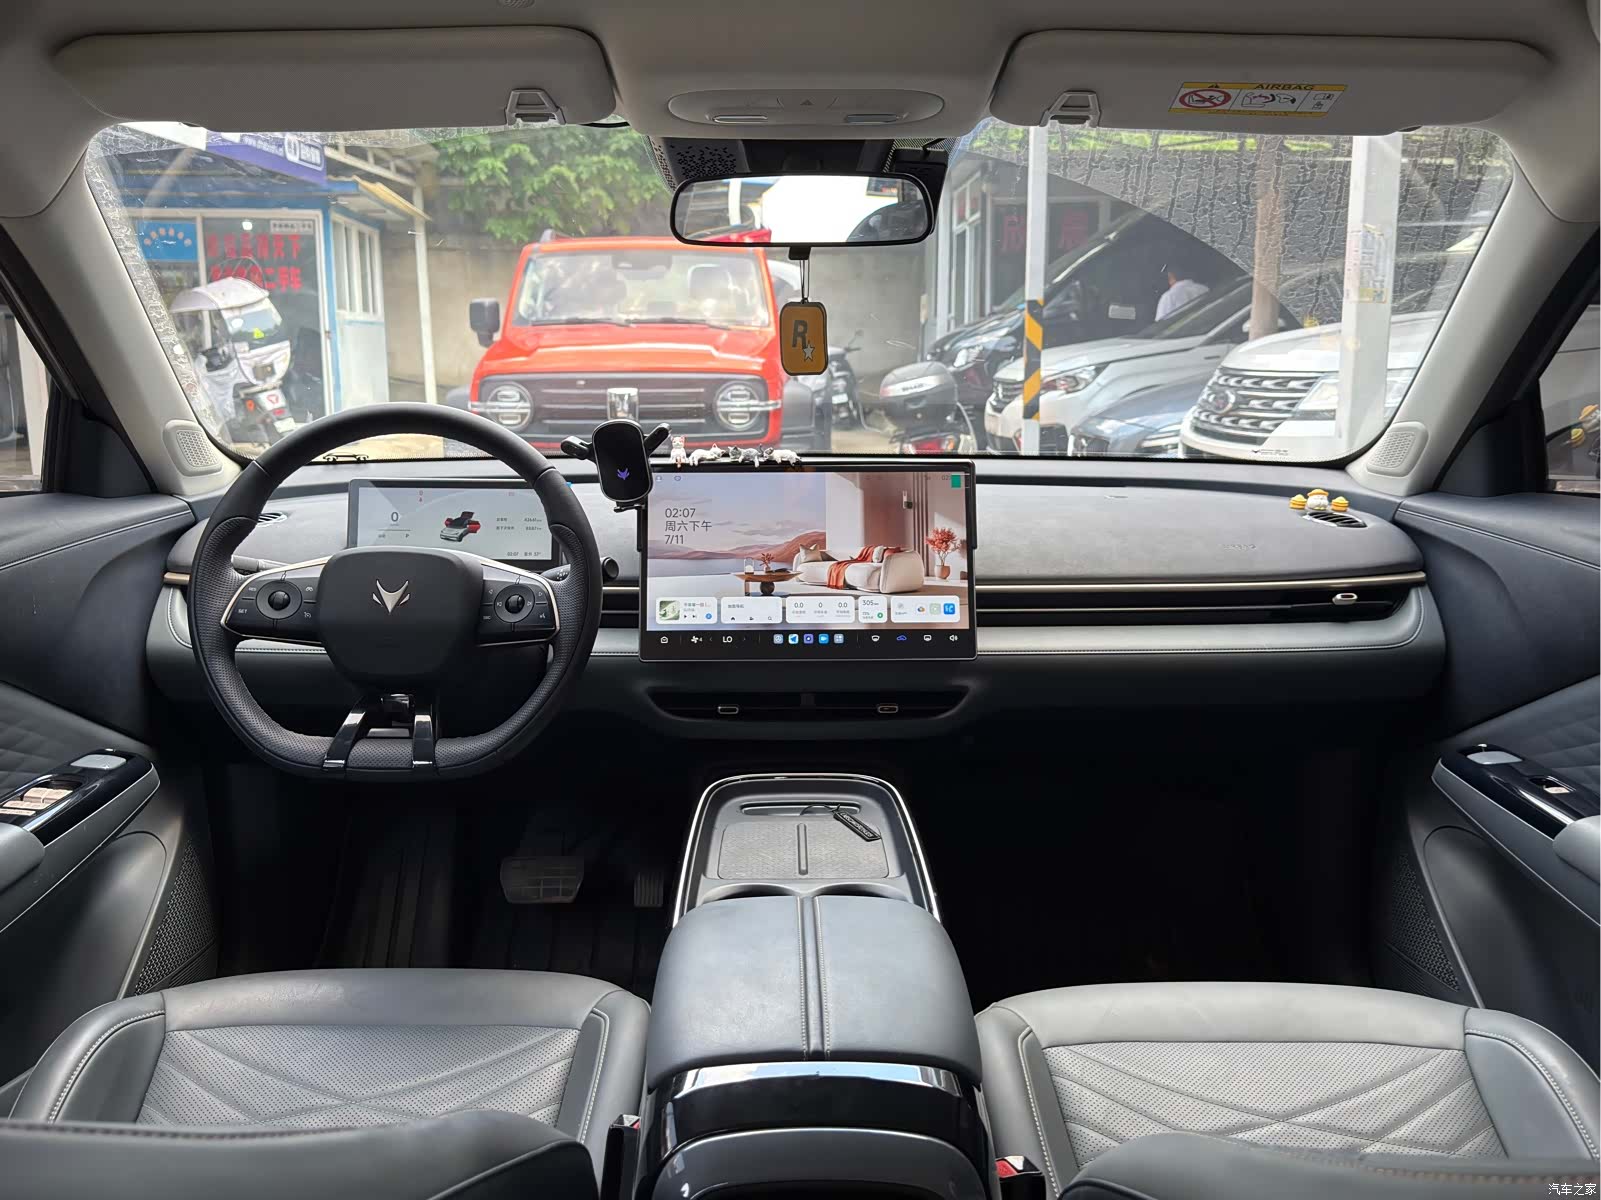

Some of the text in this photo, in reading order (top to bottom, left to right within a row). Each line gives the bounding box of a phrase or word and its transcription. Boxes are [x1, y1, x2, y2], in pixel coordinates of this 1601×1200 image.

[791, 319, 808, 349] R
[391, 512, 399, 522] 0
[664, 507, 696, 519] 02:07
[664, 520, 713, 532] 周六下午
[664, 534, 684, 545] 7/11
[793, 601, 804, 609] 0.0
[838, 601, 848, 609] 0.0
[722, 635, 733, 643] LO
